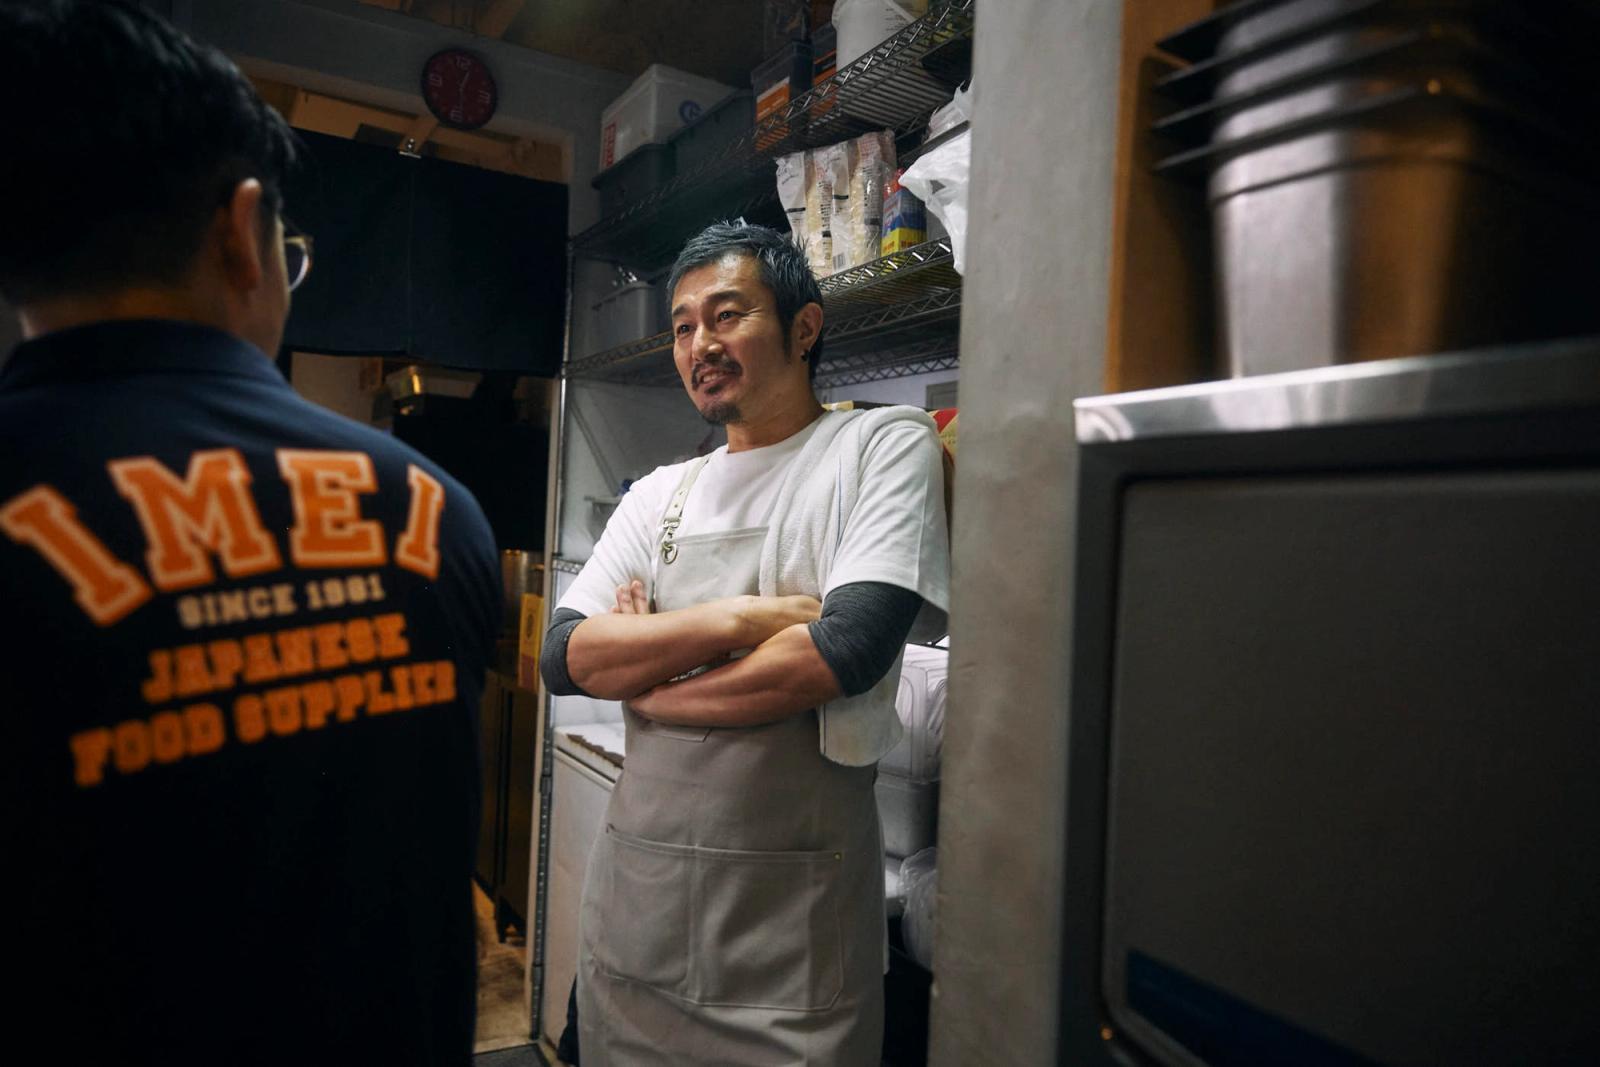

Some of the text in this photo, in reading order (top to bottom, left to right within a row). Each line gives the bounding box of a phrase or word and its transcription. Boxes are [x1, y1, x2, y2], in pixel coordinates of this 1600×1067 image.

[0, 446, 446, 627] IMEI
[140, 611, 410, 705] JAPANESE
[176, 583, 298, 630] SINCE
[67, 658, 458, 789] FOOD SUPPLIER
